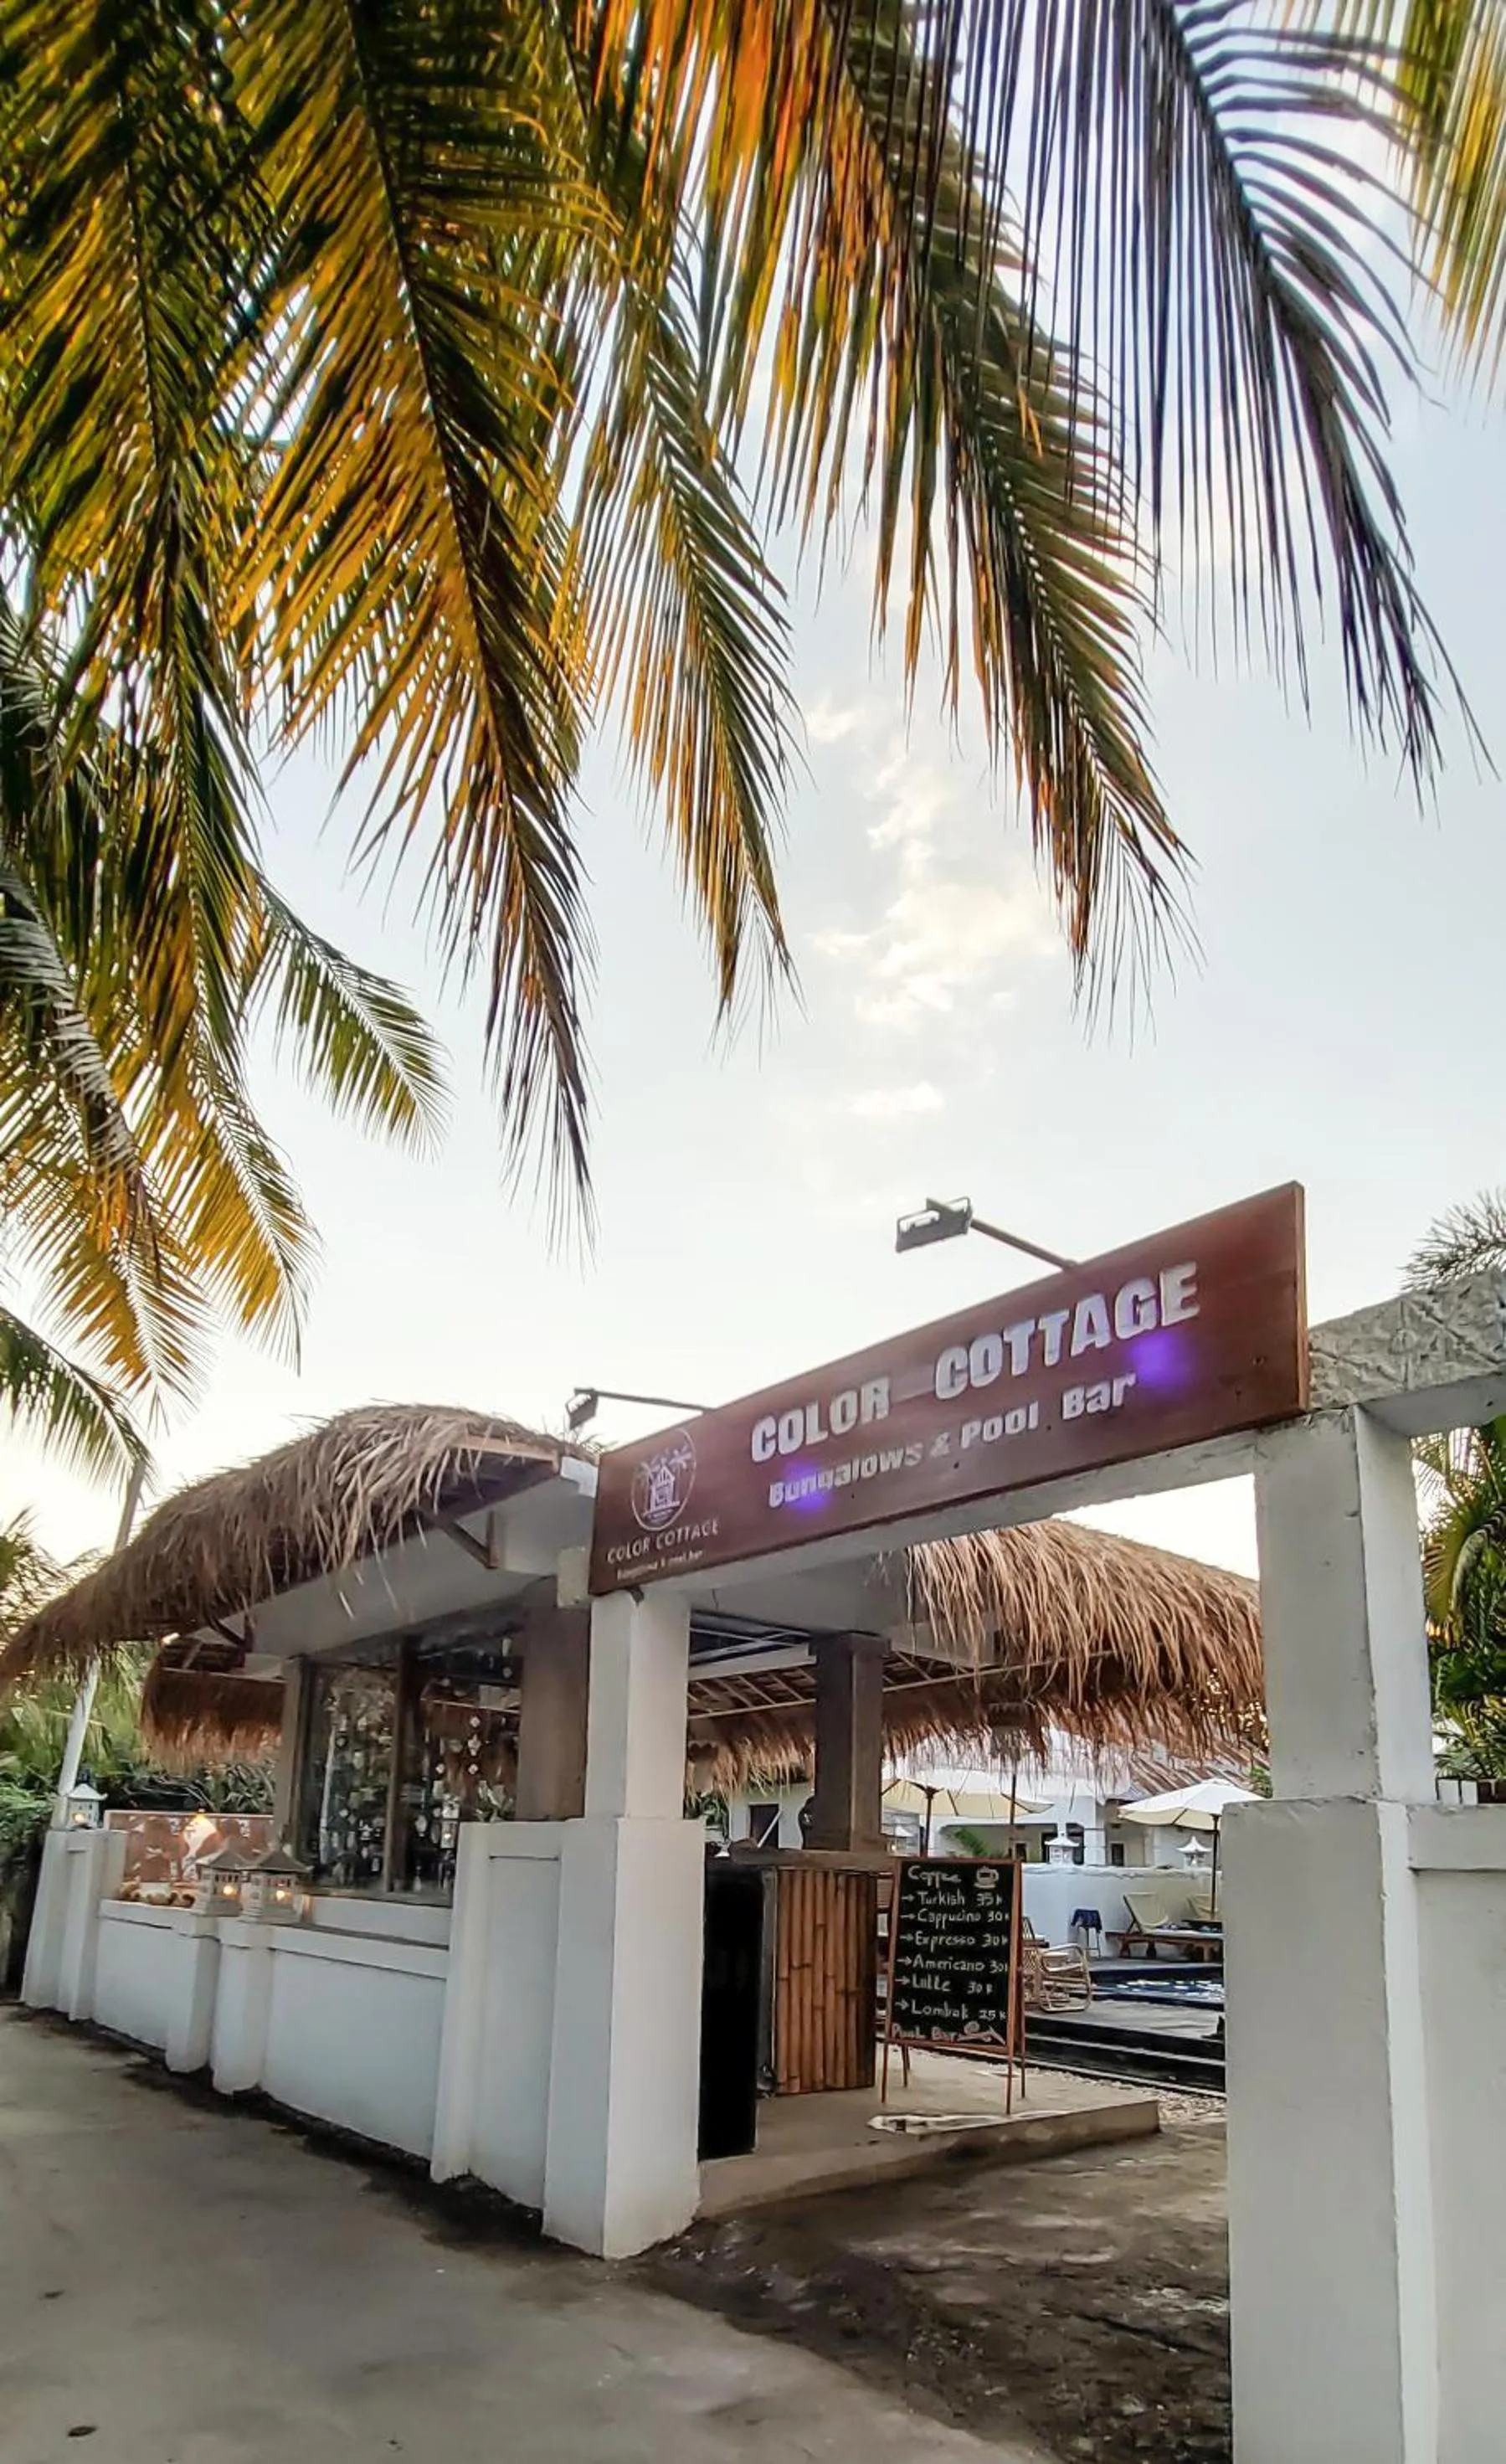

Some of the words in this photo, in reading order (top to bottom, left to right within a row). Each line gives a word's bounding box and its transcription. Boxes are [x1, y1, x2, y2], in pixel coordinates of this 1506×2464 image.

[751, 1376, 890, 1463] COLOR
[935, 1261, 1200, 1400] COTTAGE
[929, 1431, 952, 1458] &
[959, 1400, 1040, 1449] Pool
[1061, 1372, 1136, 1421] Bar
[607, 1537, 650, 1564] COLOR
[655, 1519, 719, 1549] COTTAGE
[917, 1888, 965, 1906] Turkish
[917, 1908, 981, 1930] Cappucino
[915, 1930, 975, 1953] Expresso
[912, 1953, 985, 1972] Americano
